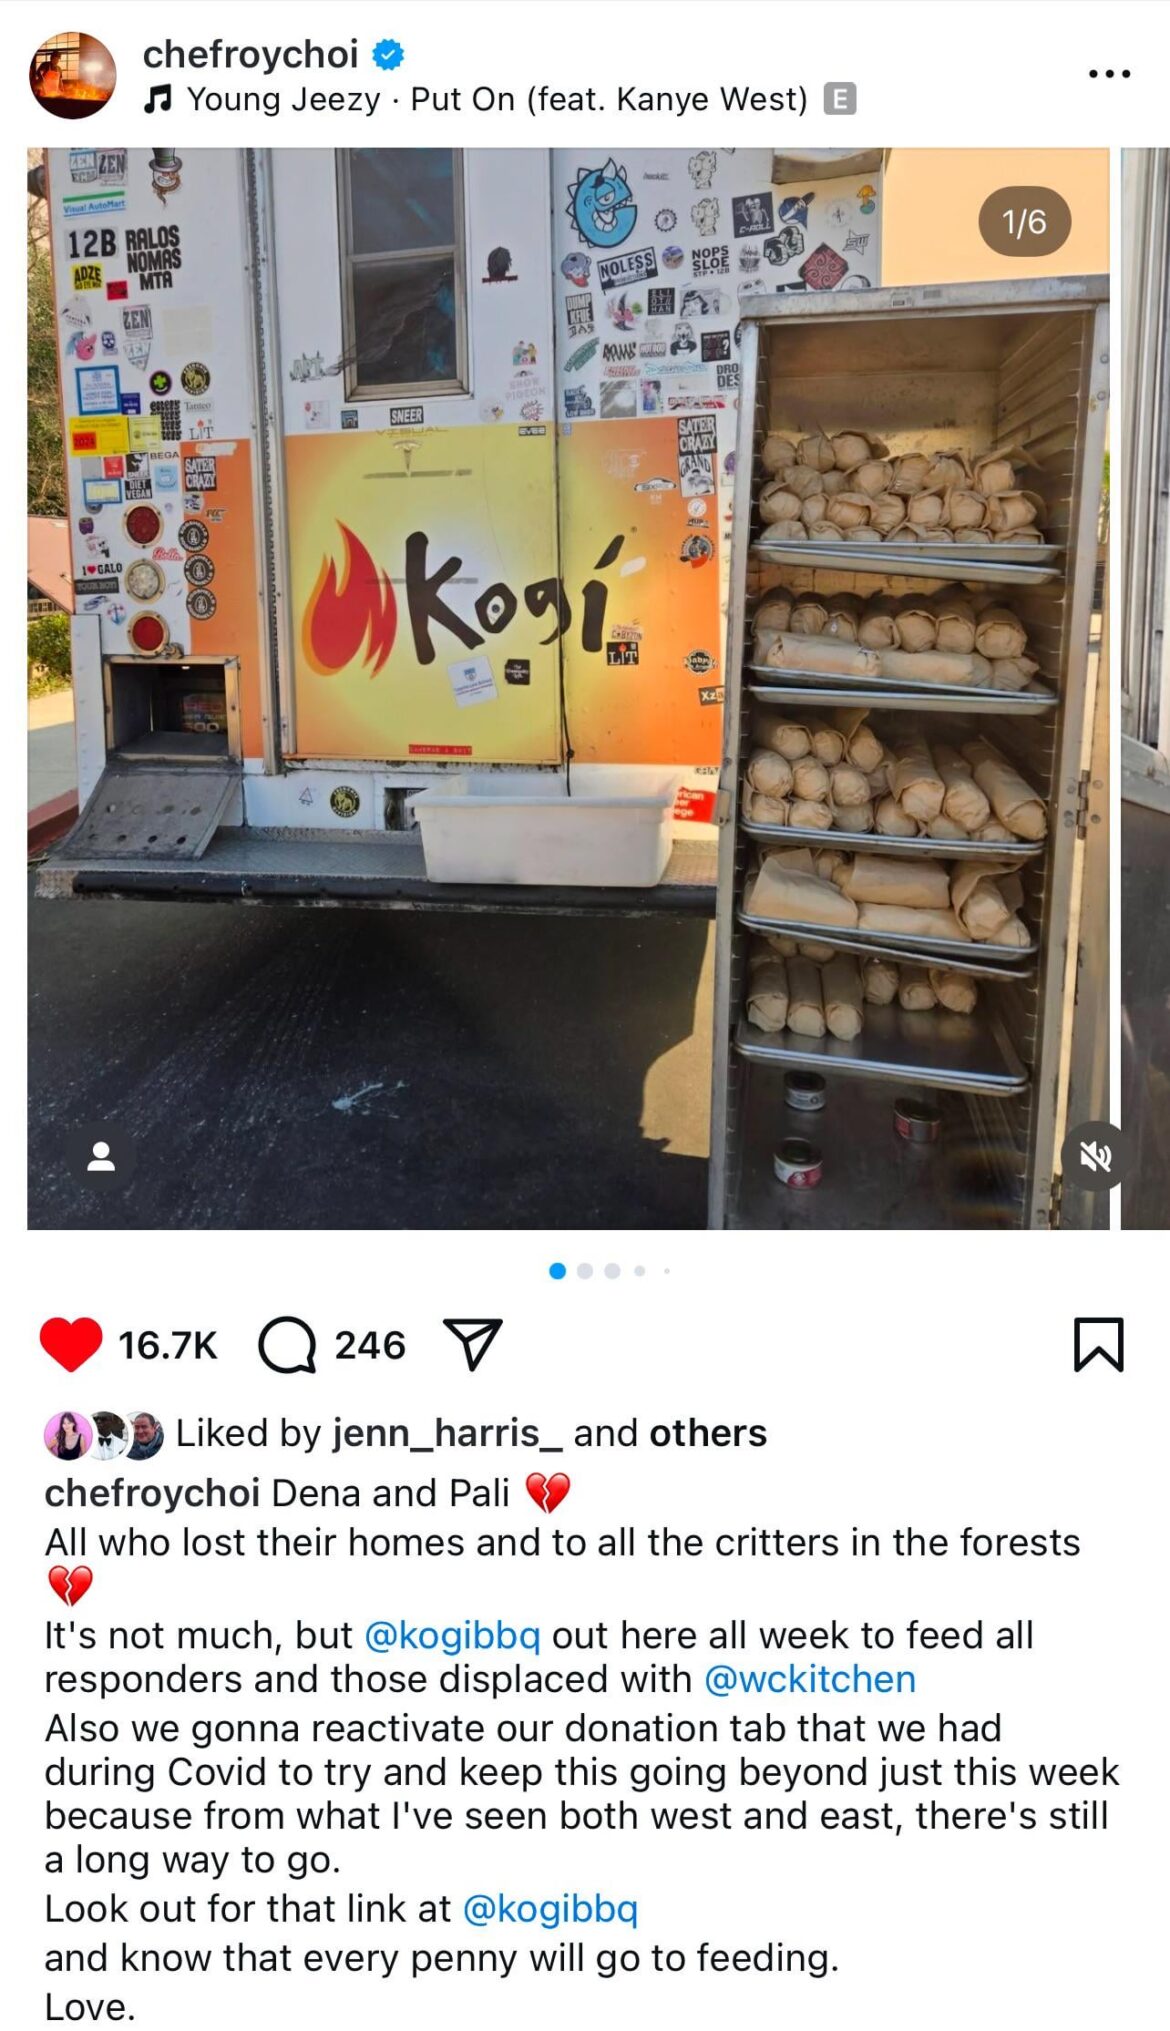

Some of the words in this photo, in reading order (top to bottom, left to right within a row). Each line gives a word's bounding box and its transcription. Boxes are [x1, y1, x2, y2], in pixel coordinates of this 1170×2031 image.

[98, 154, 125, 174] ZEN
[64, 204, 87, 214] Visual
[88, 200, 126, 210] AutoMart
[69, 229, 117, 259] 12B
[125, 225, 180, 251] RALOS
[127, 248, 182, 273] NOMAS
[692, 245, 730, 260] NOPS
[600, 252, 654, 279] NOLESS
[692, 256, 730, 271] SLOE
[74, 265, 102, 282] ADZE
[139, 271, 173, 290] MTA
[123, 310, 150, 329] ZEN
[391, 409, 422, 424] SNEER
[679, 416, 715, 435] SATER
[679, 434, 716, 451] CRAZY
[150, 452, 180, 460] BEGA
[185, 457, 215, 473] SATER
[186, 473, 216, 490] CRAZY
[126, 489, 152, 500] VEGAN
[97, 563, 123, 575] GALO
